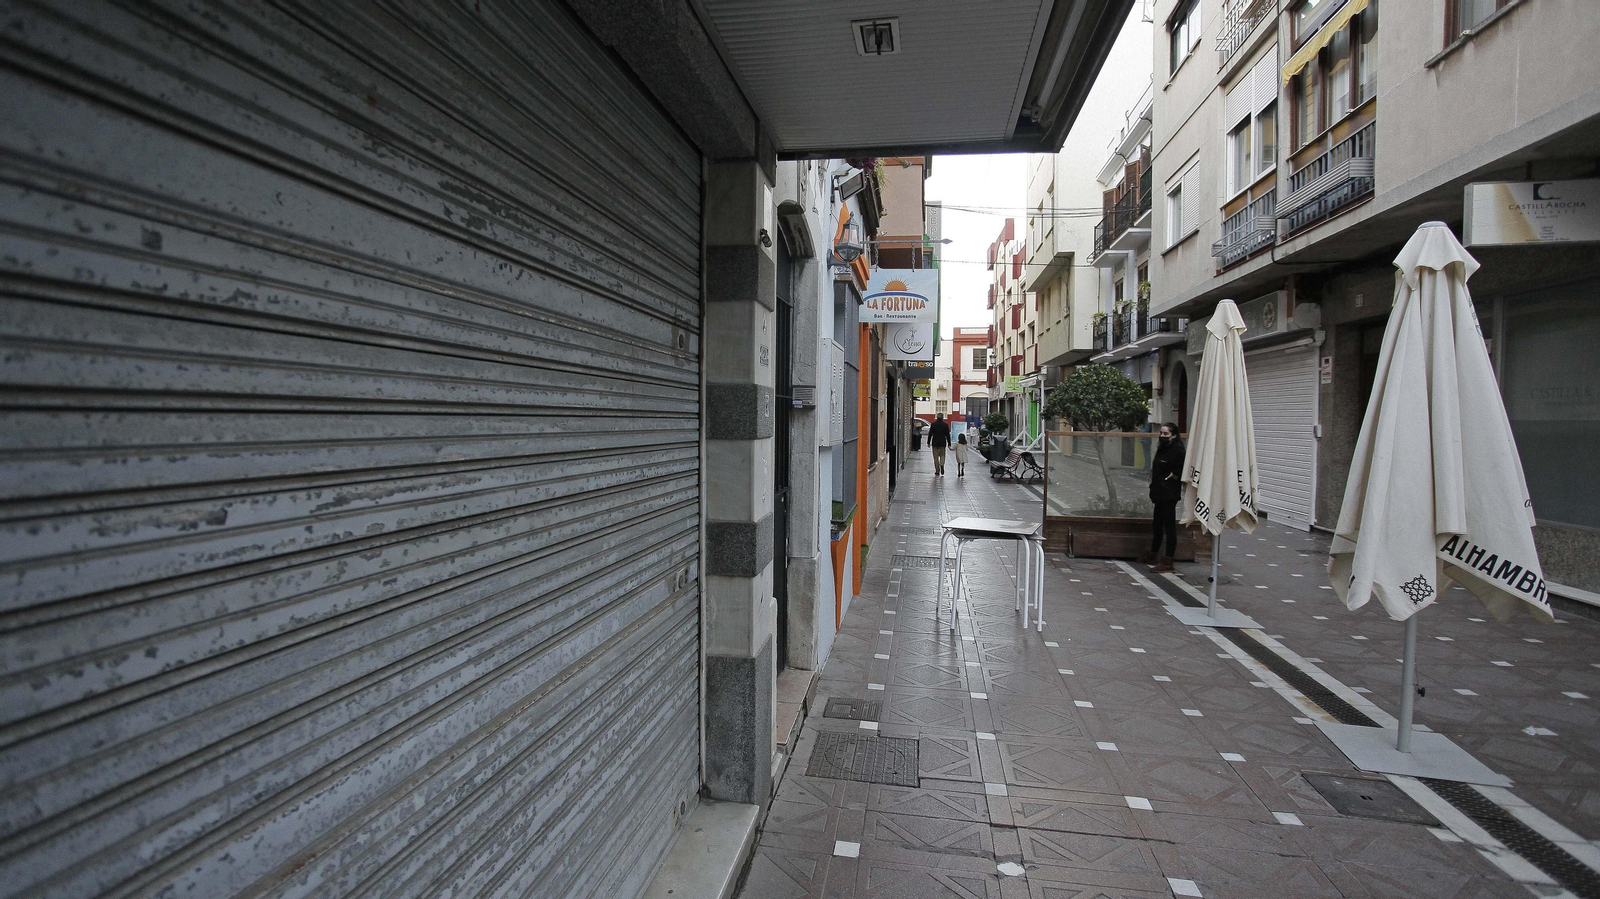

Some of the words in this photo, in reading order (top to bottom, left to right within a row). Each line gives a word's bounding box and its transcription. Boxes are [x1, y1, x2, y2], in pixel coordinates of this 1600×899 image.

[867, 299, 878, 310] LA
[881, 297, 926, 311] FORTUNA
[902, 339, 921, 350] Elena
[908, 361, 933, 369] traverso
[1440, 535, 1551, 605] ALHAMBR
